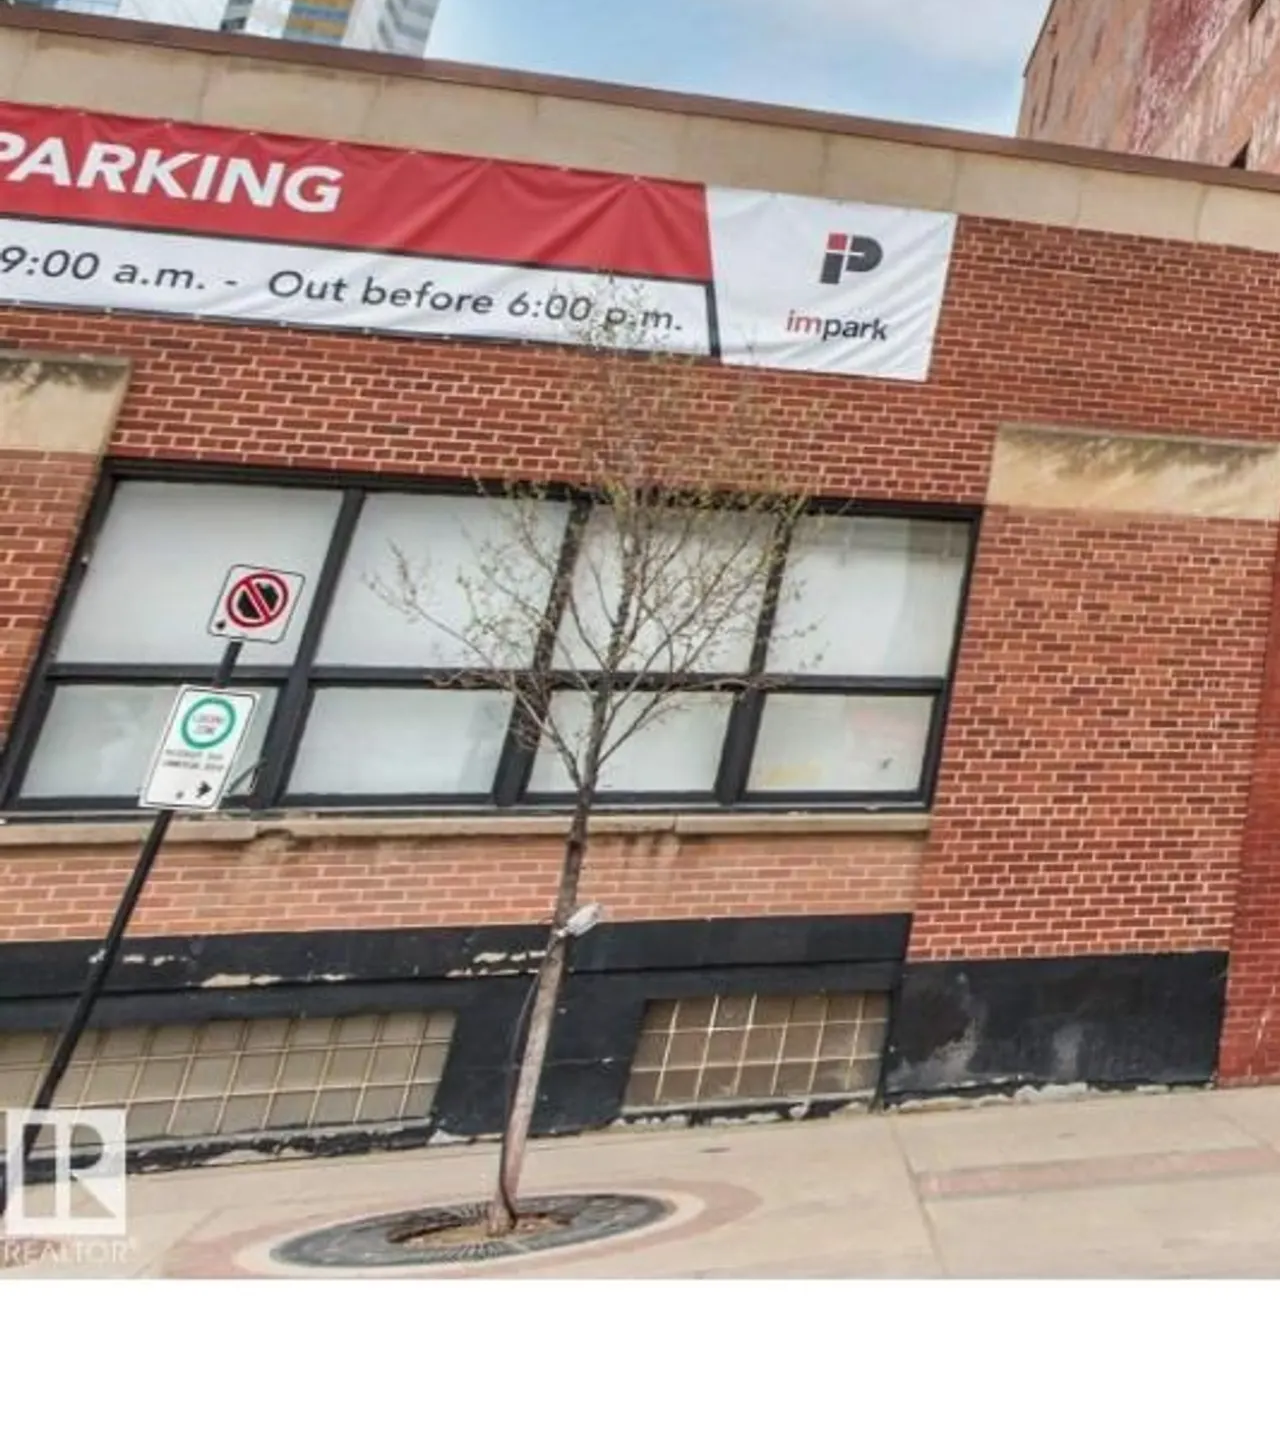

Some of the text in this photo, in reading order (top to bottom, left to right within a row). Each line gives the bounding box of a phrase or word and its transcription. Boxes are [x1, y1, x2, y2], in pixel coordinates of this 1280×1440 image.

[0, 245, 101, 280] 9:00
[113, 263, 206, 290] a.m.
[268, 270, 348, 302] Out
[361, 275, 493, 314] before
[508, 290, 591, 321] 6:00
[786, 309, 888, 342] impark
